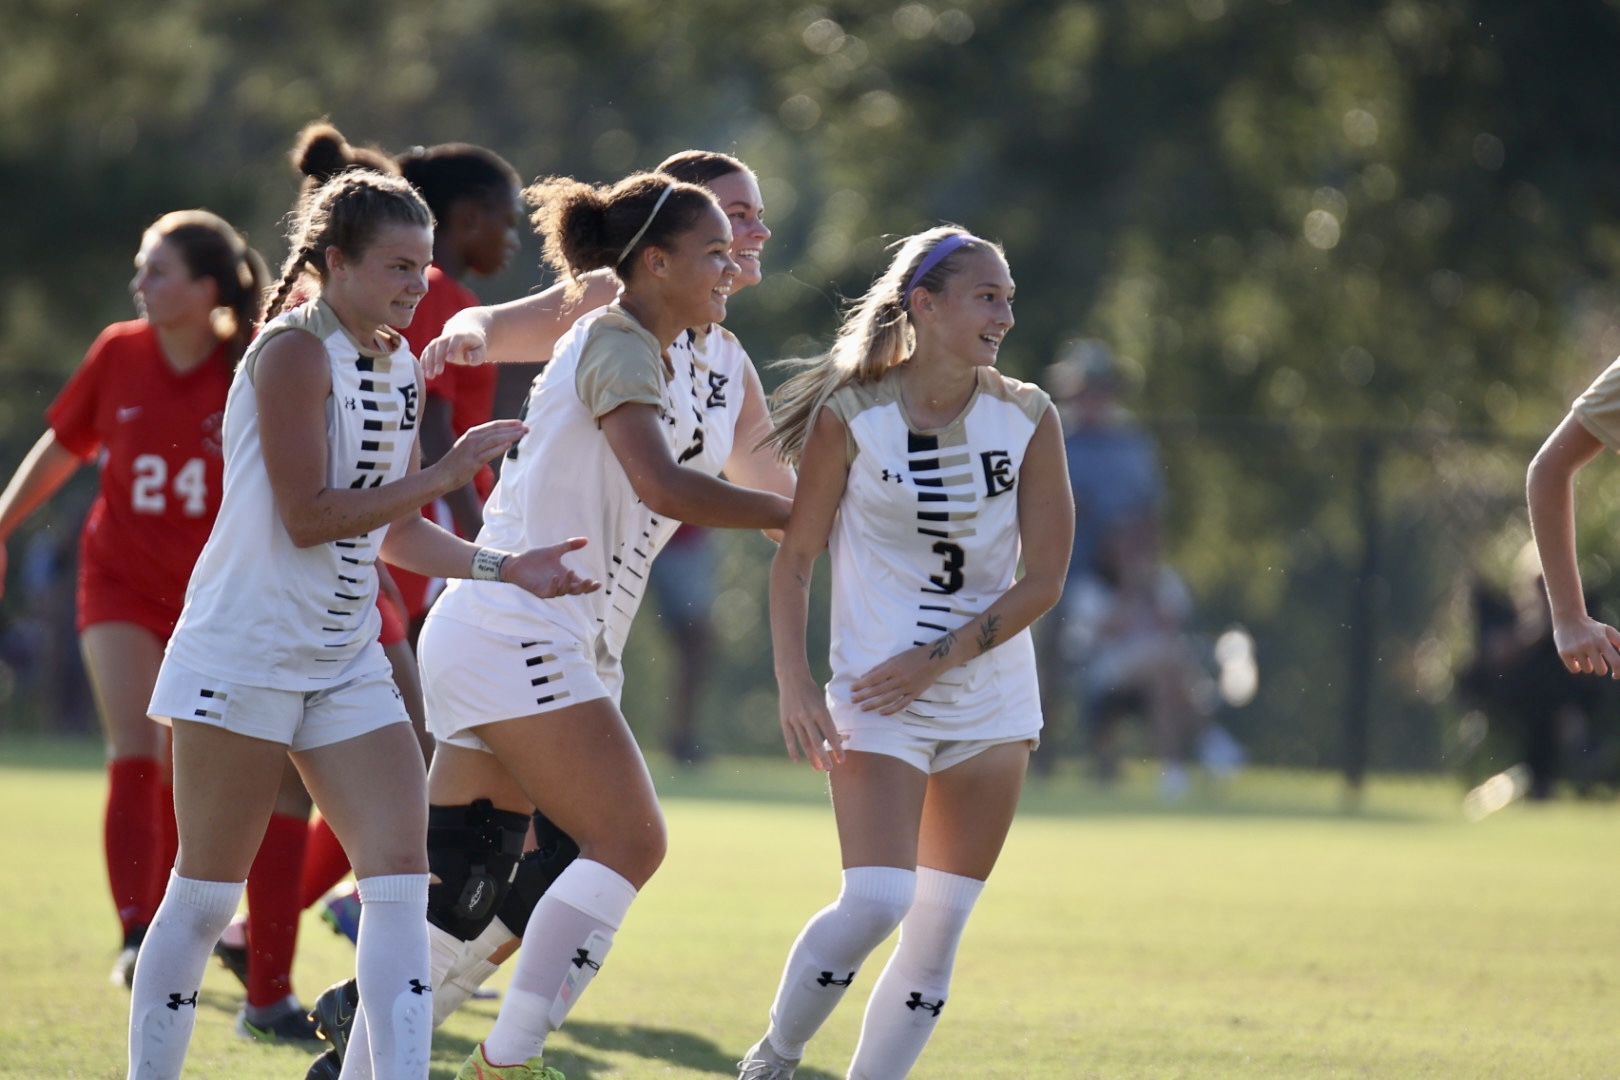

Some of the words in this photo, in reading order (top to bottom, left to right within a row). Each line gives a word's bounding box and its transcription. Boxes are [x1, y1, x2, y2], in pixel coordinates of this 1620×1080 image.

[132, 454, 207, 515] 24
[980, 450, 1016, 498] EC
[930, 541, 965, 595] 3
